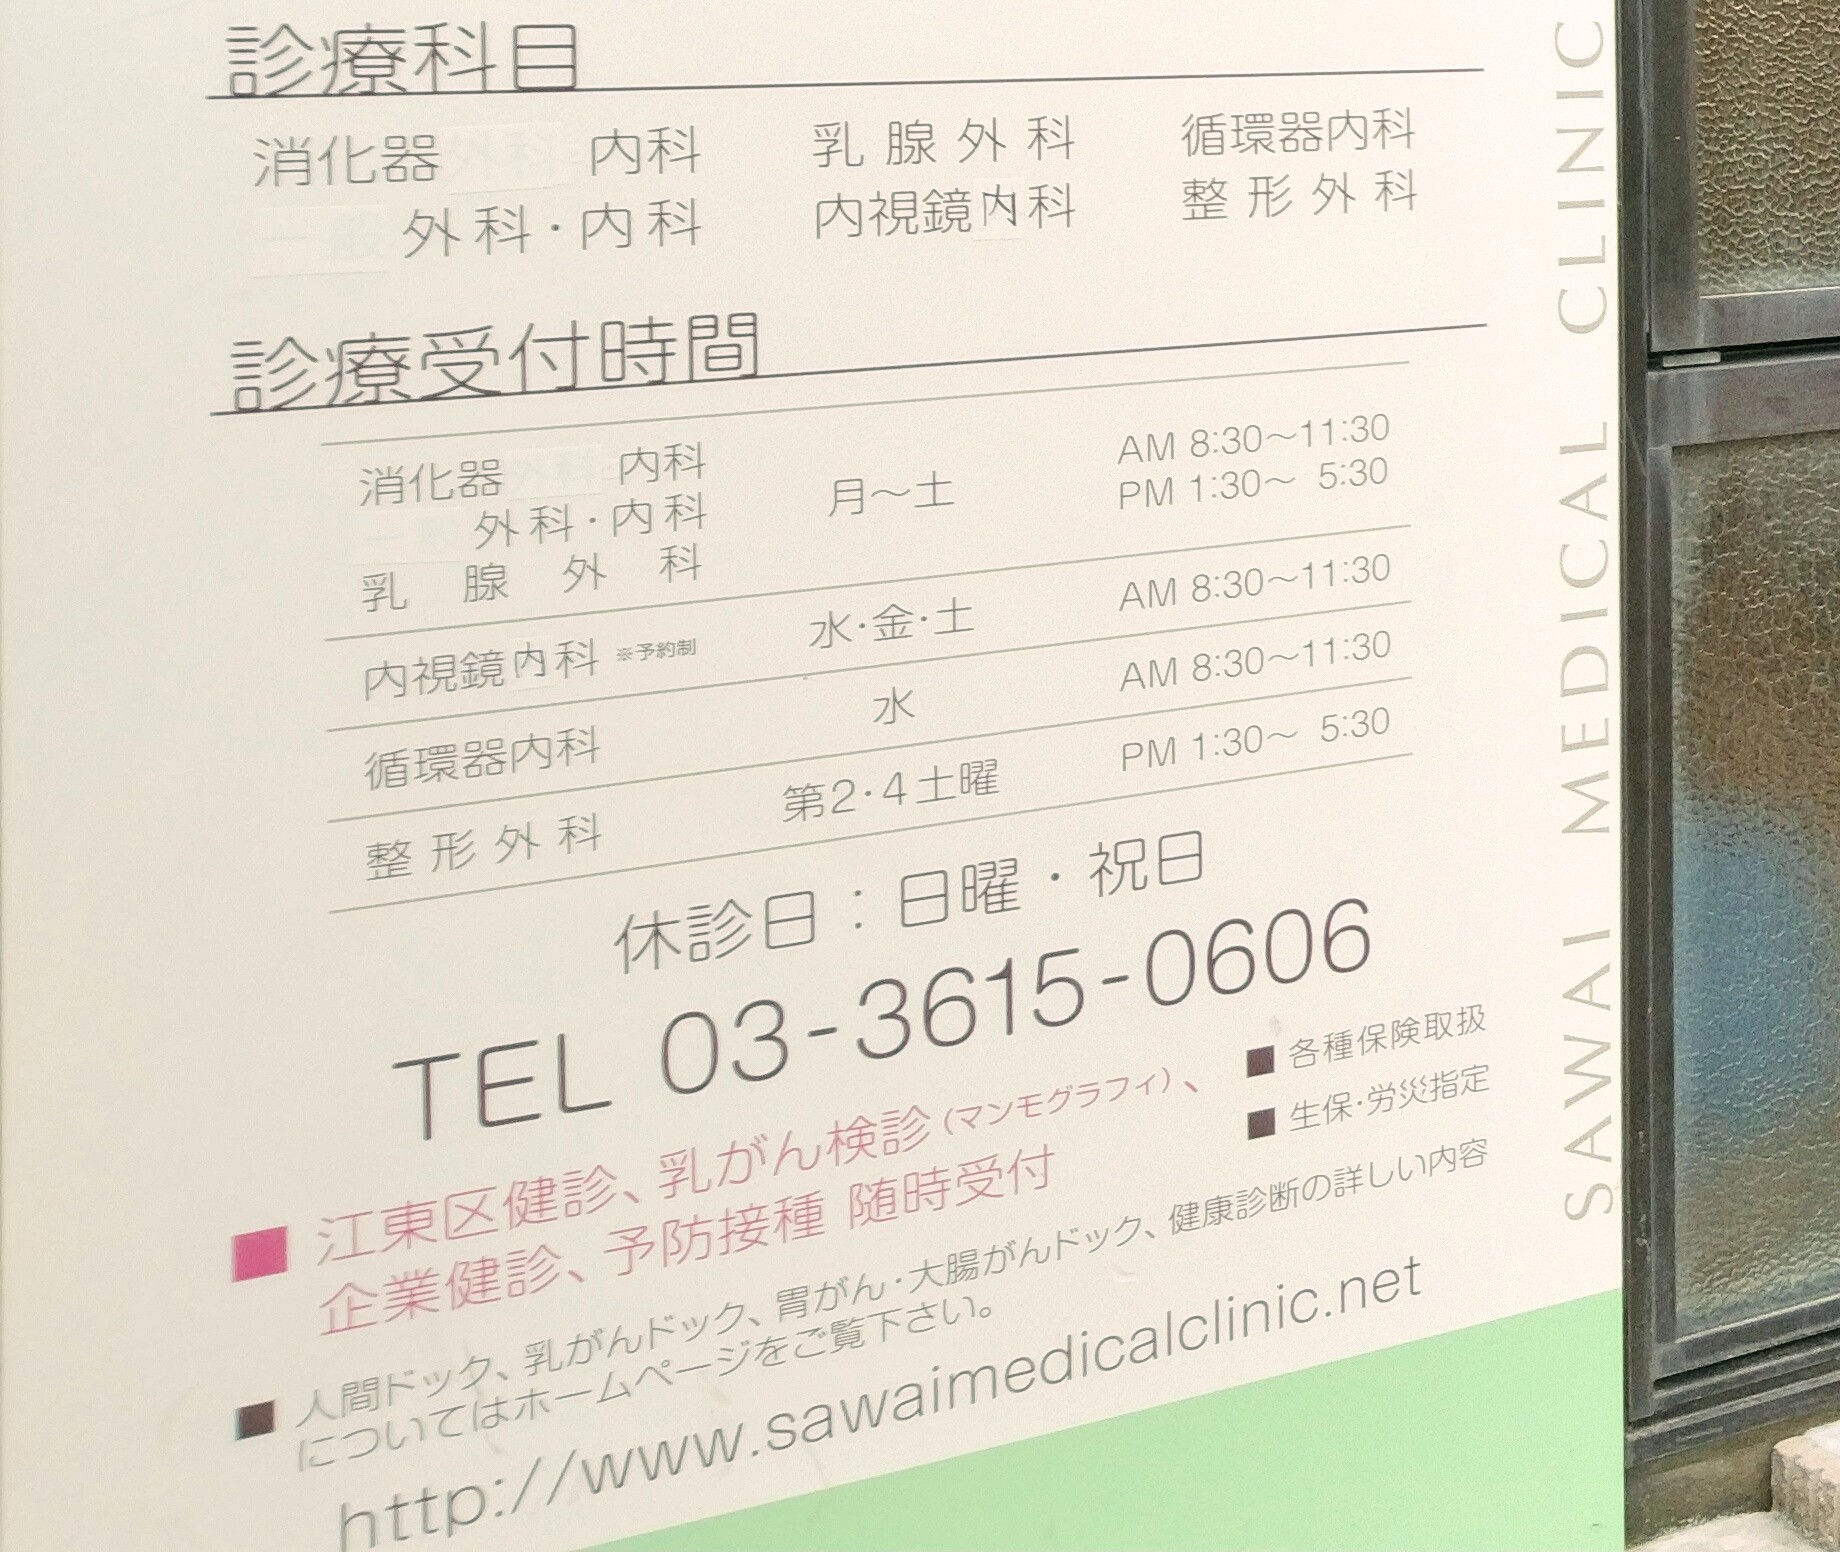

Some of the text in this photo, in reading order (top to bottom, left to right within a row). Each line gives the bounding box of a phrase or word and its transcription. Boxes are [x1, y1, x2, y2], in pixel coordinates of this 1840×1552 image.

[226, 21, 578, 96] 診療科目
[253, 125, 701, 188] 消化器 内科
[812, 114, 1076, 169] 乳腺外科
[1180, 106, 1417, 159] 循環器内科
[814, 182, 1076, 240] 内視鏡内科
[1181, 168, 1419, 222] 整形外科
[230, 312, 758, 414] 診療受付時間
[359, 441, 707, 507] 消化器 内科
[1117, 431, 1175, 465] AM
[1119, 476, 1173, 509] PM
[1119, 577, 1176, 612] AM
[1554, 19, 1614, 1223] SAWAI MEDICAL CLINIC
[364, 637, 599, 702] 内視鏡内科
[1120, 656, 1177, 692] AM
[872, 686, 917, 727] 水
[363, 725, 601, 792] 循環器内科
[1122, 736, 1176, 771] PM
[366, 812, 603, 881] 整形外科
[392, 897, 1372, 1141] TEL 03-3615-0606
[1288, 1003, 1487, 1071] 各種保険取扱
[1289, 1063, 1491, 1133] 生保・労災指定
[848, 1143, 1056, 1230] 随時受付
[297, 1294, 993, 1473] についてはホームページをご覧下さい。
[339, 1254, 1423, 1552] http://www.sawaimedicalclinic.net
